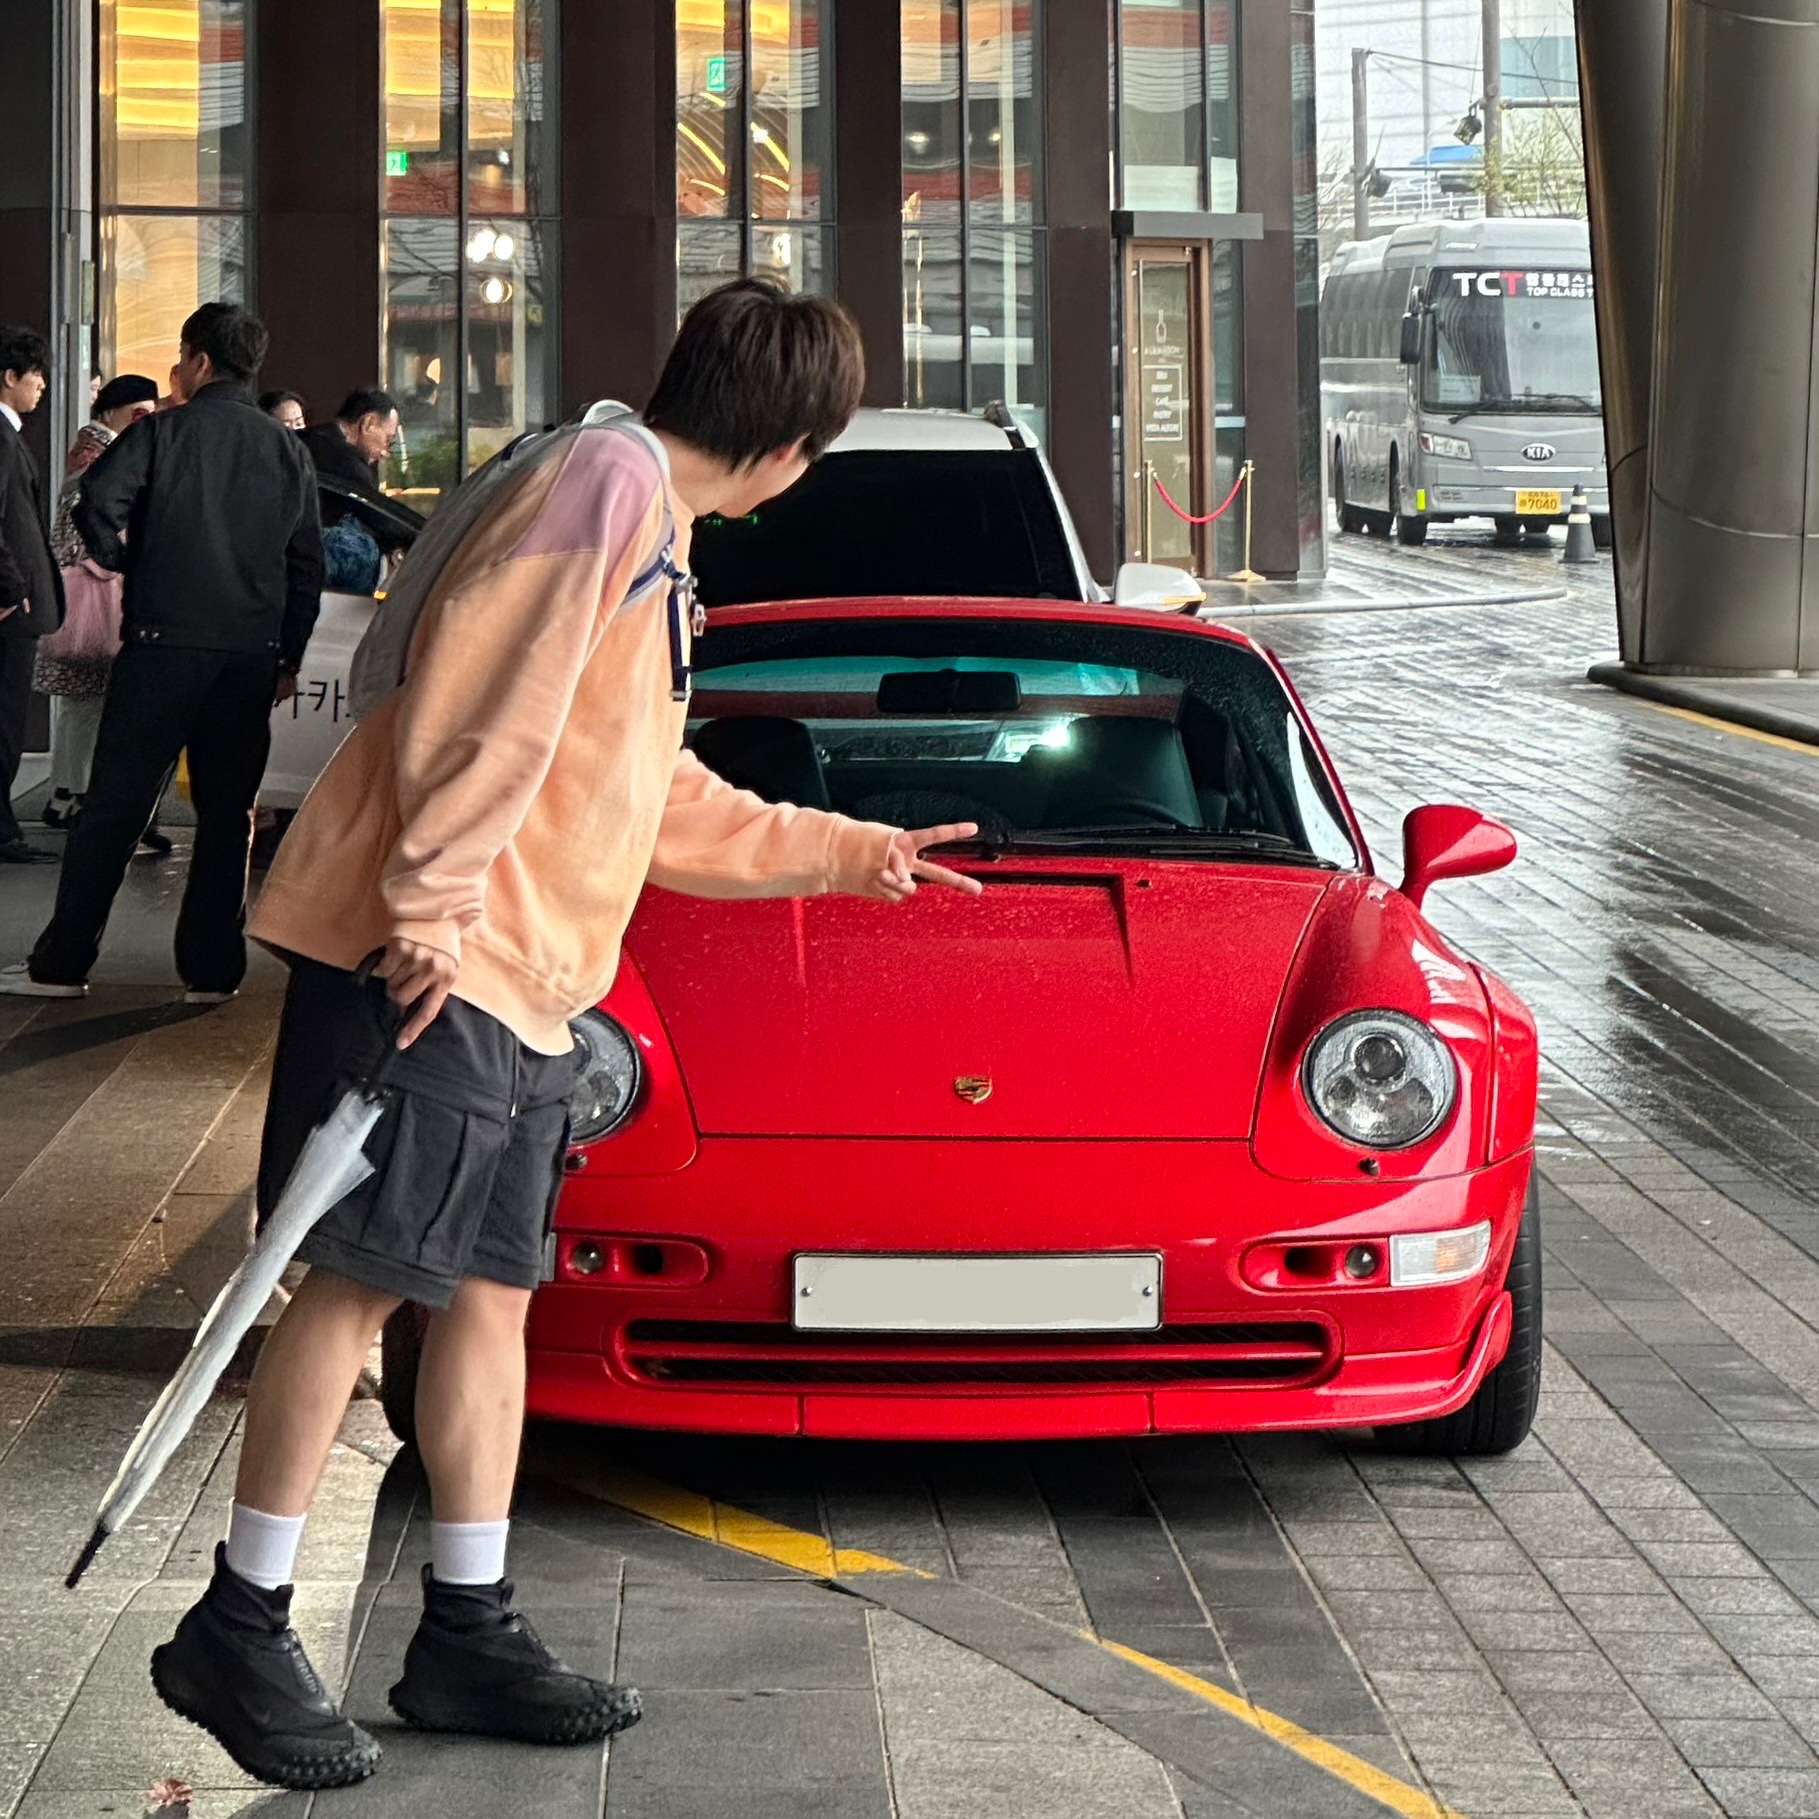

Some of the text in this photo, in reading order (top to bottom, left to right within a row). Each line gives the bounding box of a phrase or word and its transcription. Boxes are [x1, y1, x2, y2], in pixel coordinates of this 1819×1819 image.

[1453, 272, 1524, 297] TCT
[1526, 286, 1548, 297] TOP
[1526, 447, 1550, 459] KIA
[1528, 498, 1557, 510] 7040
